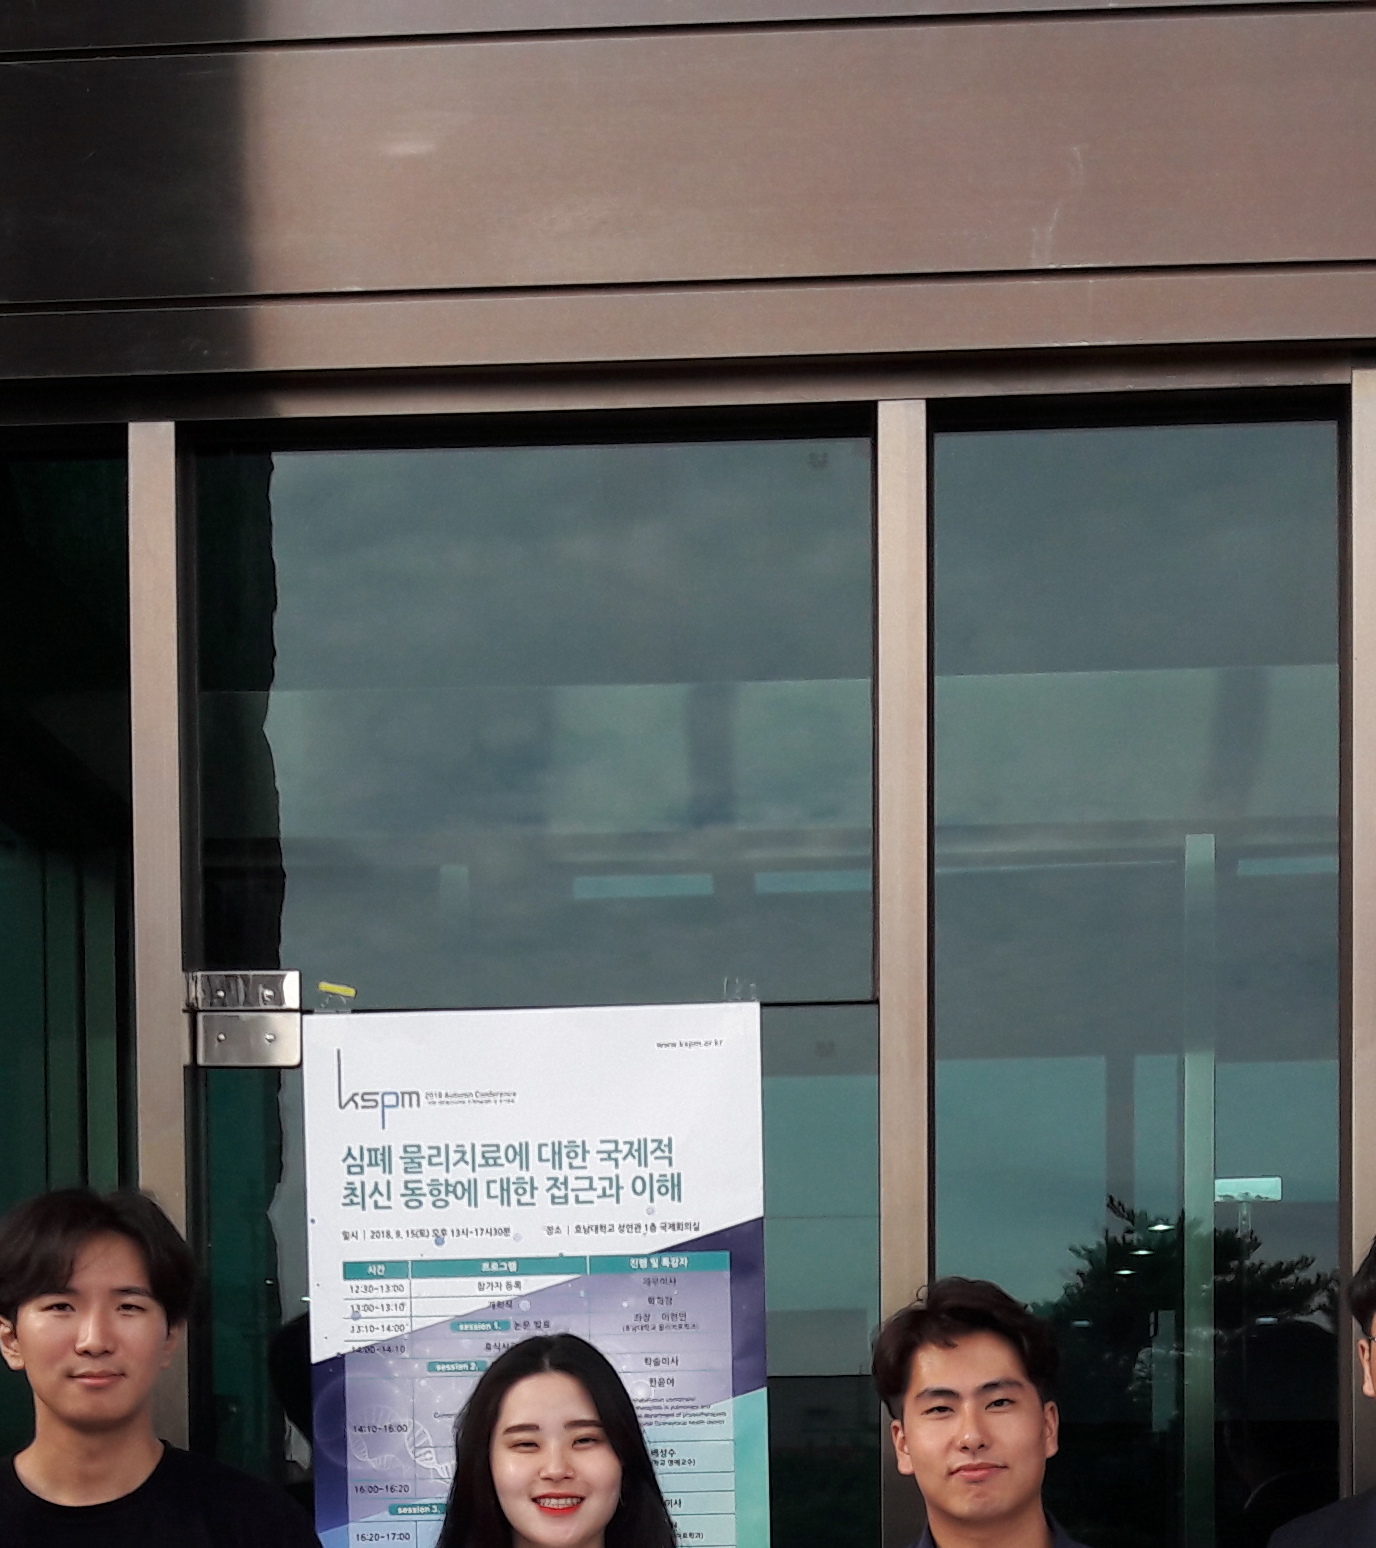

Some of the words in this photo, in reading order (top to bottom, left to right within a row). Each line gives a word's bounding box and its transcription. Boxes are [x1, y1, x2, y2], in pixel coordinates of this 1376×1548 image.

[342, 1145, 393, 1176] 심폐
[399, 1140, 530, 1175] 물리치료에
[537, 1139, 591, 1171] 대한
[595, 1136, 673, 1170] 국제적
[341, 1179, 393, 1211] 최신
[400, 1177, 479, 1210] 동향에
[486, 1175, 539, 1208] 대한
[545, 1173, 625, 1206] 접근과
[631, 1172, 682, 1204] 이해
[574, 1223, 615, 1234] 호남대학교
[458, 1322, 492, 1331] session
[435, 1362, 467, 1372] session
[397, 1506, 430, 1514] session
